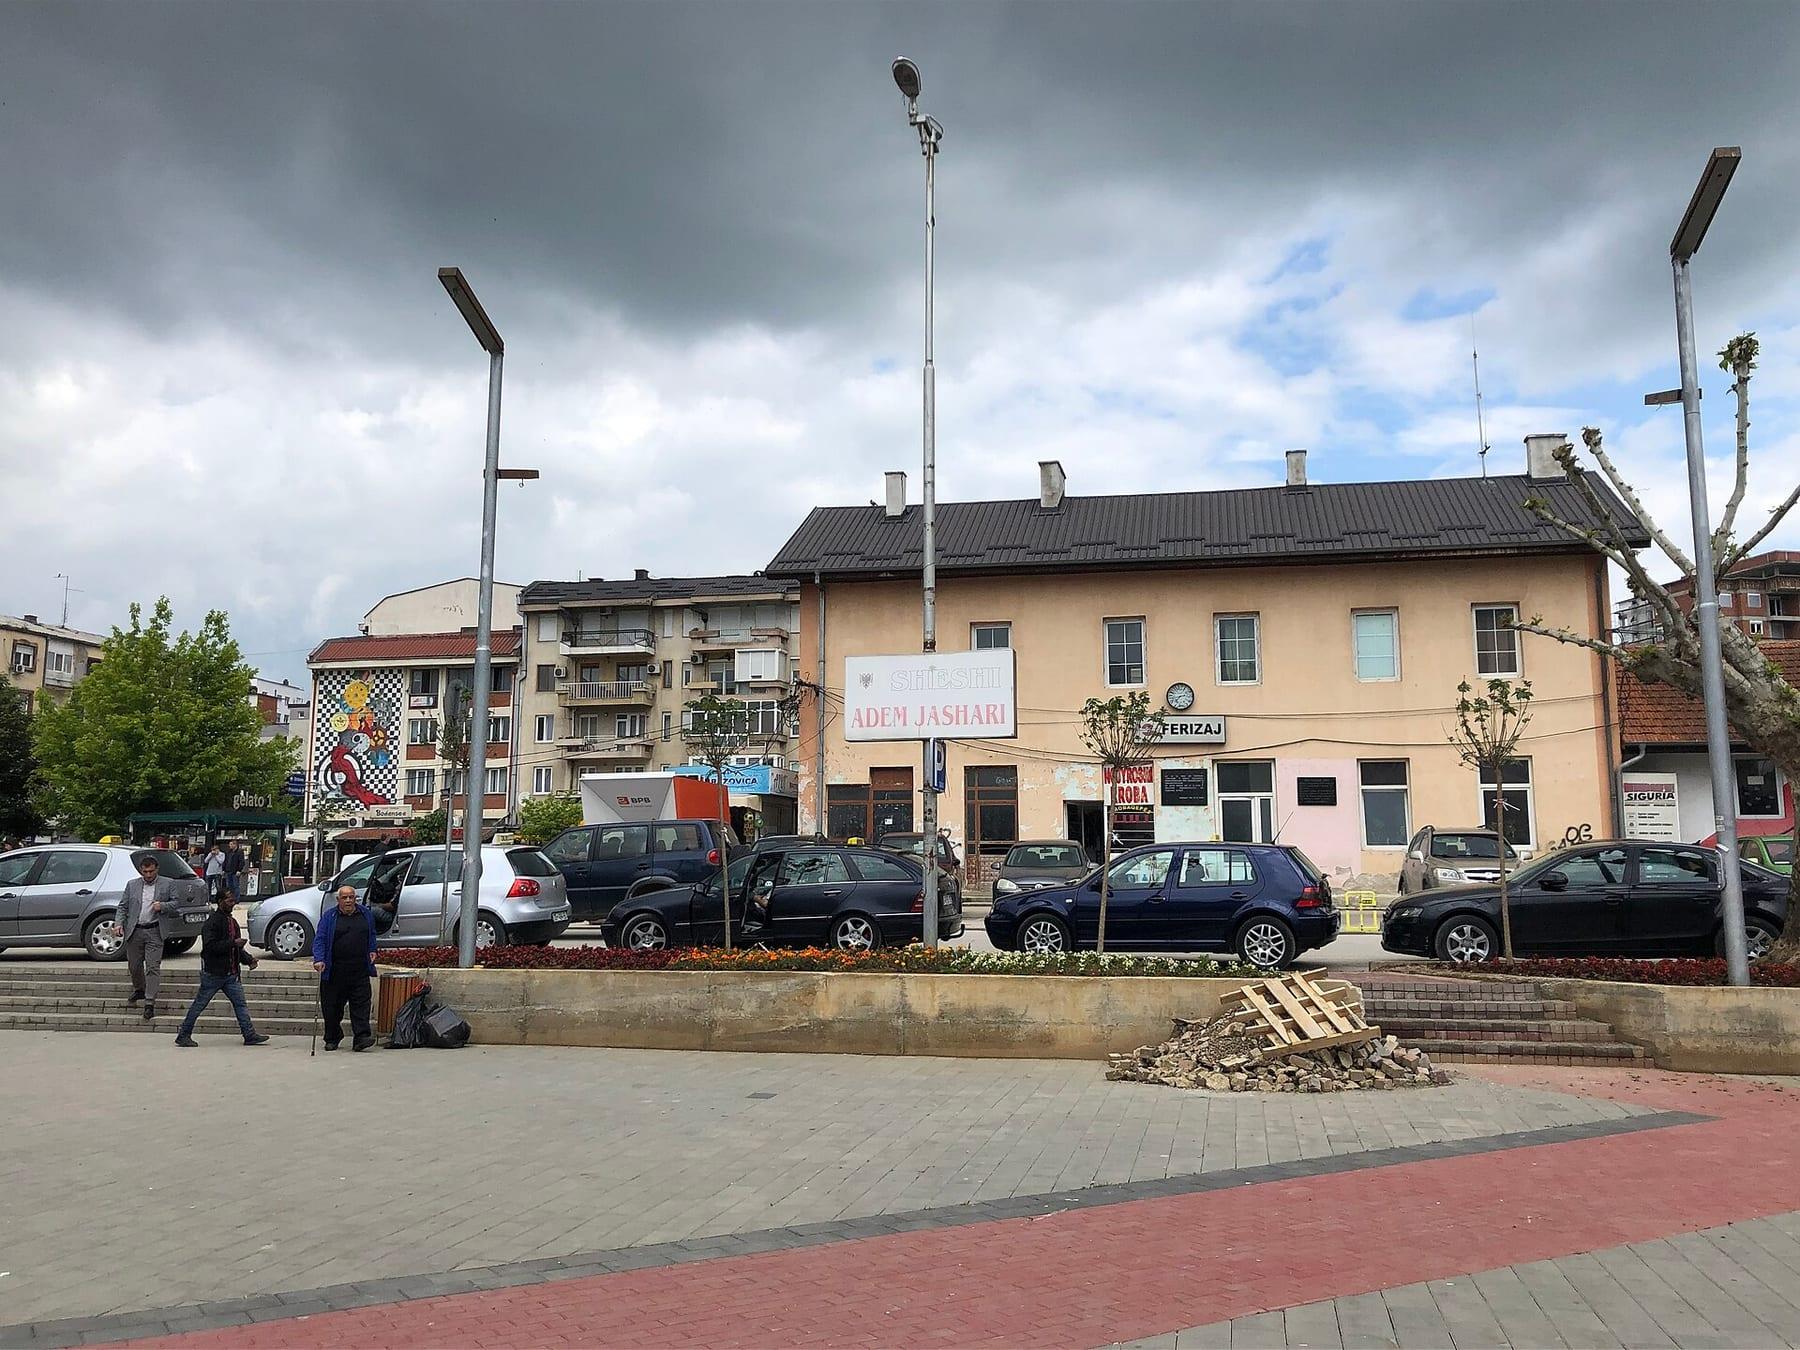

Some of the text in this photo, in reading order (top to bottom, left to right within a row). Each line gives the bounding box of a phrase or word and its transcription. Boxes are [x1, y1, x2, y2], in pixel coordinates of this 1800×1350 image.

[890, 666, 1001, 691] SHESHI
[851, 703, 1006, 728] ADEM JASHARI
[1162, 723, 1222, 735] FERIZAJ
[233, 791, 273, 810] gelato 1
[1110, 785, 1148, 804] ROBA
[1627, 792, 1675, 801] SIGURIA
